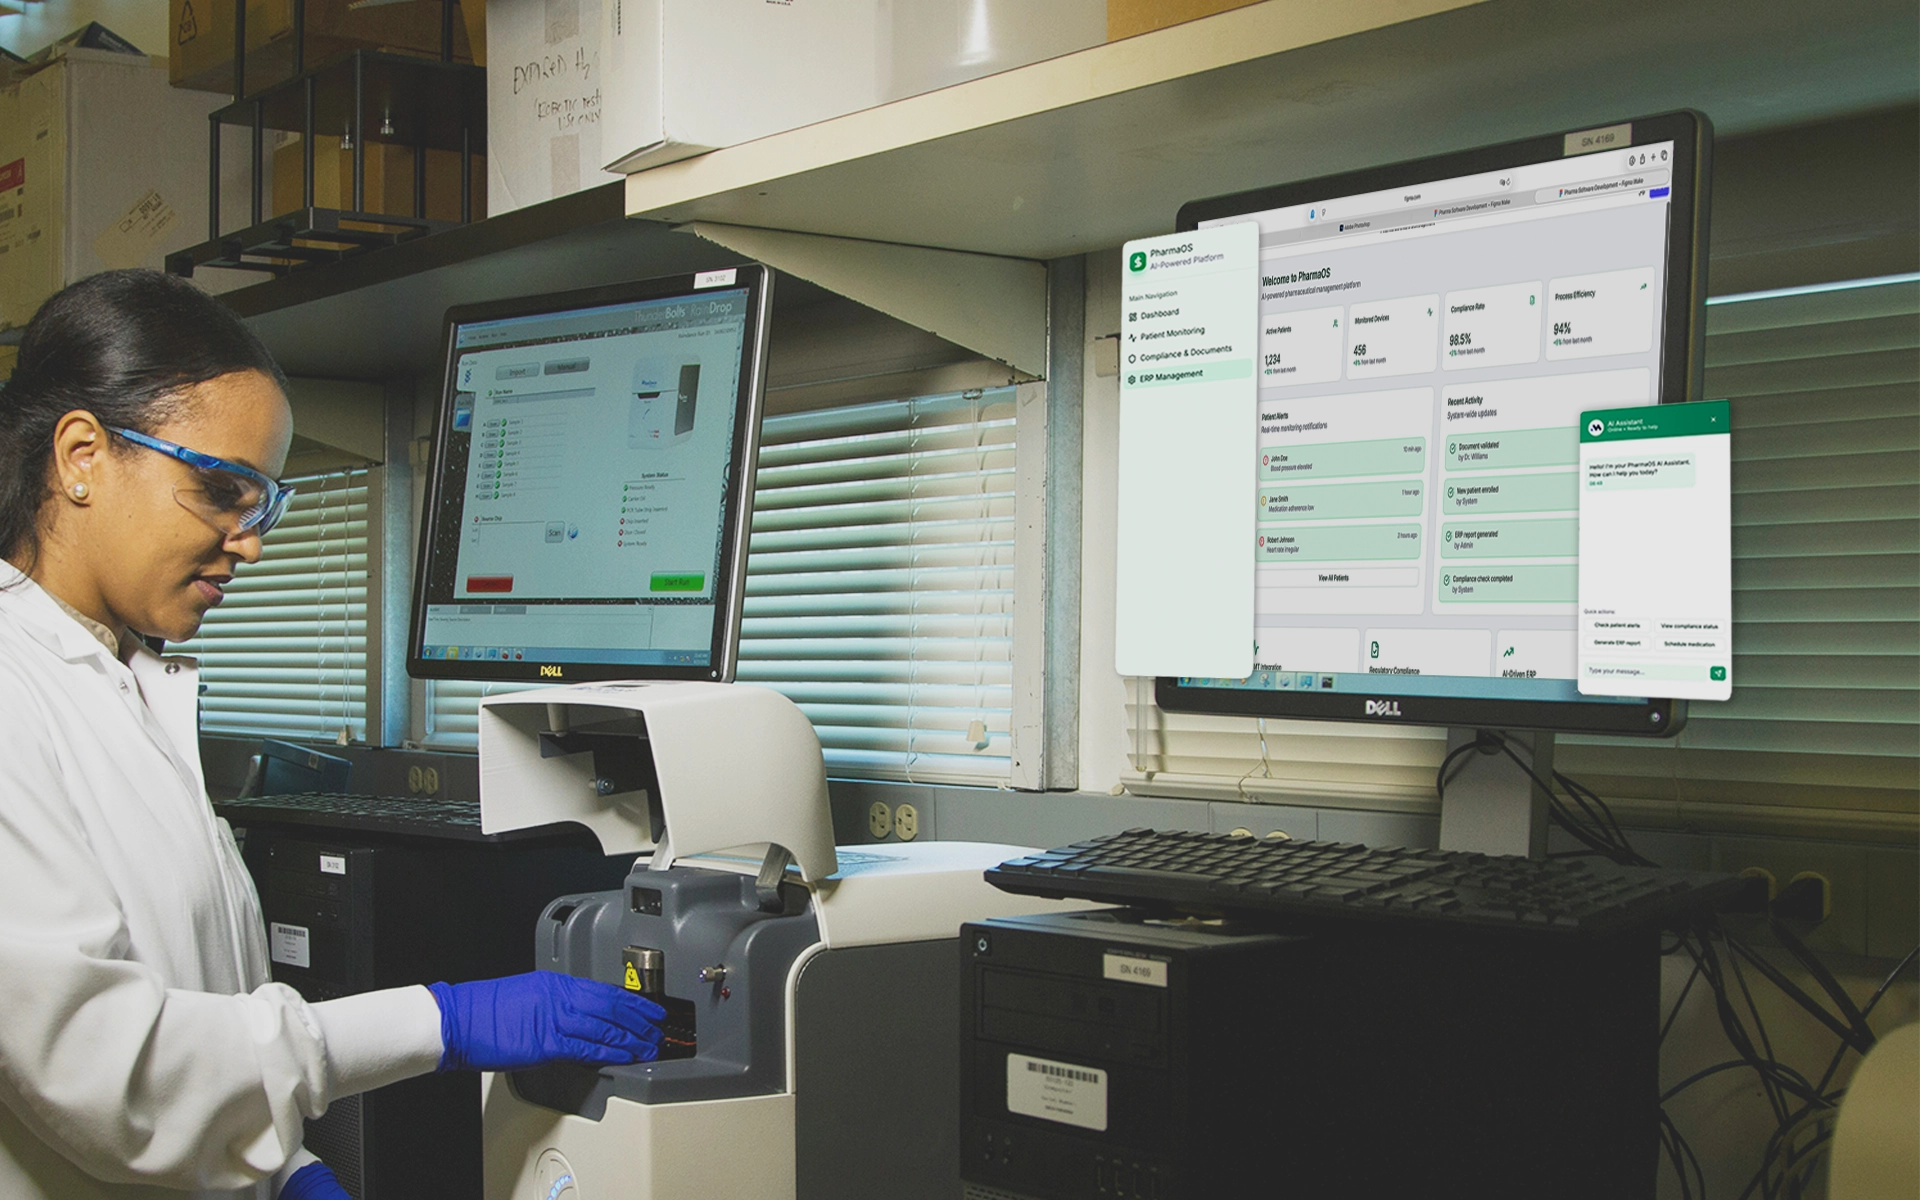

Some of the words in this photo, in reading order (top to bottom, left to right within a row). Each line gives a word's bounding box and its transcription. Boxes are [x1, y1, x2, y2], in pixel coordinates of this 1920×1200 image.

[1582, 136, 1594, 147] SN
[1595, 133, 1615, 144] 4169
[1594, 182, 1618, 191] Development
[1150, 243, 1194, 258] PharmaOS
[1150, 258, 1192, 270] AI-Powered
[1193, 252, 1224, 264] Platform
[1262, 274, 1289, 287] Welcome
[1291, 273, 1297, 283] to
[1298, 267, 1331, 281] PharmaOS
[1145, 290, 1178, 301] Navigation
[1261, 290, 1285, 301] AI-powered
[1285, 286, 1316, 298] pharmaceutical
[1316, 284, 1343, 294] management
[1343, 280, 1361, 290] platform
[1555, 292, 1573, 300] Process
[1573, 290, 1596, 299] Efficiency
[1140, 308, 1180, 320] Dashboard
[1450, 304, 1474, 314] Compliance
[1354, 316, 1374, 324] Monitored
[1374, 314, 1389, 322] Devices
[1140, 330, 1165, 341] Patient
[1166, 326, 1205, 338] Monitoring
[1266, 327, 1277, 335] Active
[1277, 326, 1291, 334] Patients
[1553, 322, 1571, 335] 94%
[1450, 332, 1471, 346] 98.5%
[1140, 350, 1182, 362] Compliance
[1190, 345, 1232, 356] Documents
[1354, 344, 1366, 355] 456
[1265, 354, 1281, 367] 1,234
[1140, 374, 1154, 383] ERP
[1155, 370, 1203, 382] Management
[1448, 397, 1464, 406] Recent
[1464, 396, 1483, 406] Activity
[1262, 413, 1276, 421] Patient
[1277, 412, 1288, 420] Alerts
[1447, 410, 1477, 421] System-wide
[1478, 409, 1497, 419] updates
[1261, 425, 1280, 434] Real-time
[1280, 423, 1302, 433] monitoring
[1303, 422, 1328, 430] notifications
[1459, 442, 1480, 451] Document
[1467, 487, 1481, 495] patient
[1462, 498, 1478, 506] System
[1464, 531, 1476, 539] report
[1477, 530, 1498, 539] generated
[1454, 542, 1460, 550] by
[1453, 575, 1476, 583] Compliance
[1490, 575, 1513, 583] completed
[1452, 586, 1458, 594] by
[1458, 586, 1474, 594] System
[540, 665, 562, 677] DELL
[1502, 670, 1525, 678] AI-Driven
[1365, 700, 1401, 716] DELL
[1120, 964, 1131, 974] SN
